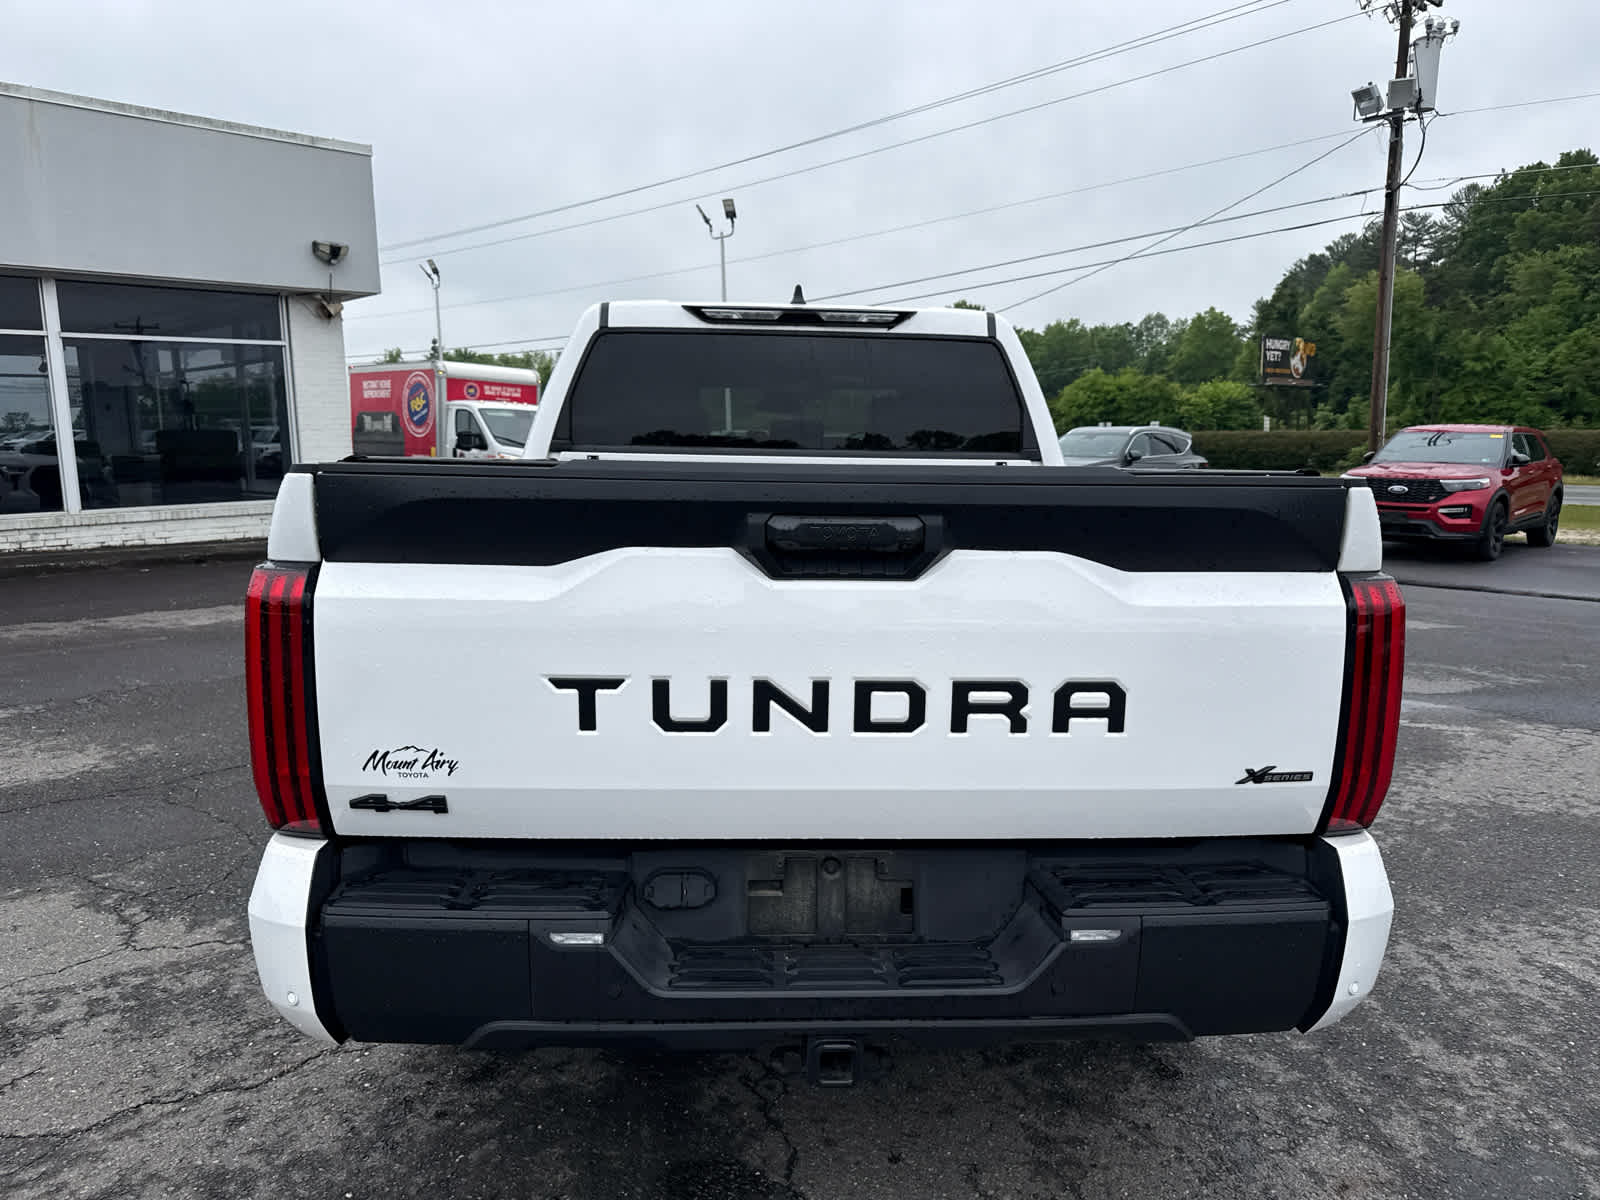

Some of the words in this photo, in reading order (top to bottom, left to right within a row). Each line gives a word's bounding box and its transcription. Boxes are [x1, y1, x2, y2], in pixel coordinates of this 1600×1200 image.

[544, 676, 1128, 735] TUNDRA
[362, 749, 419, 776] Mount
[421, 748, 459, 776] Airy
